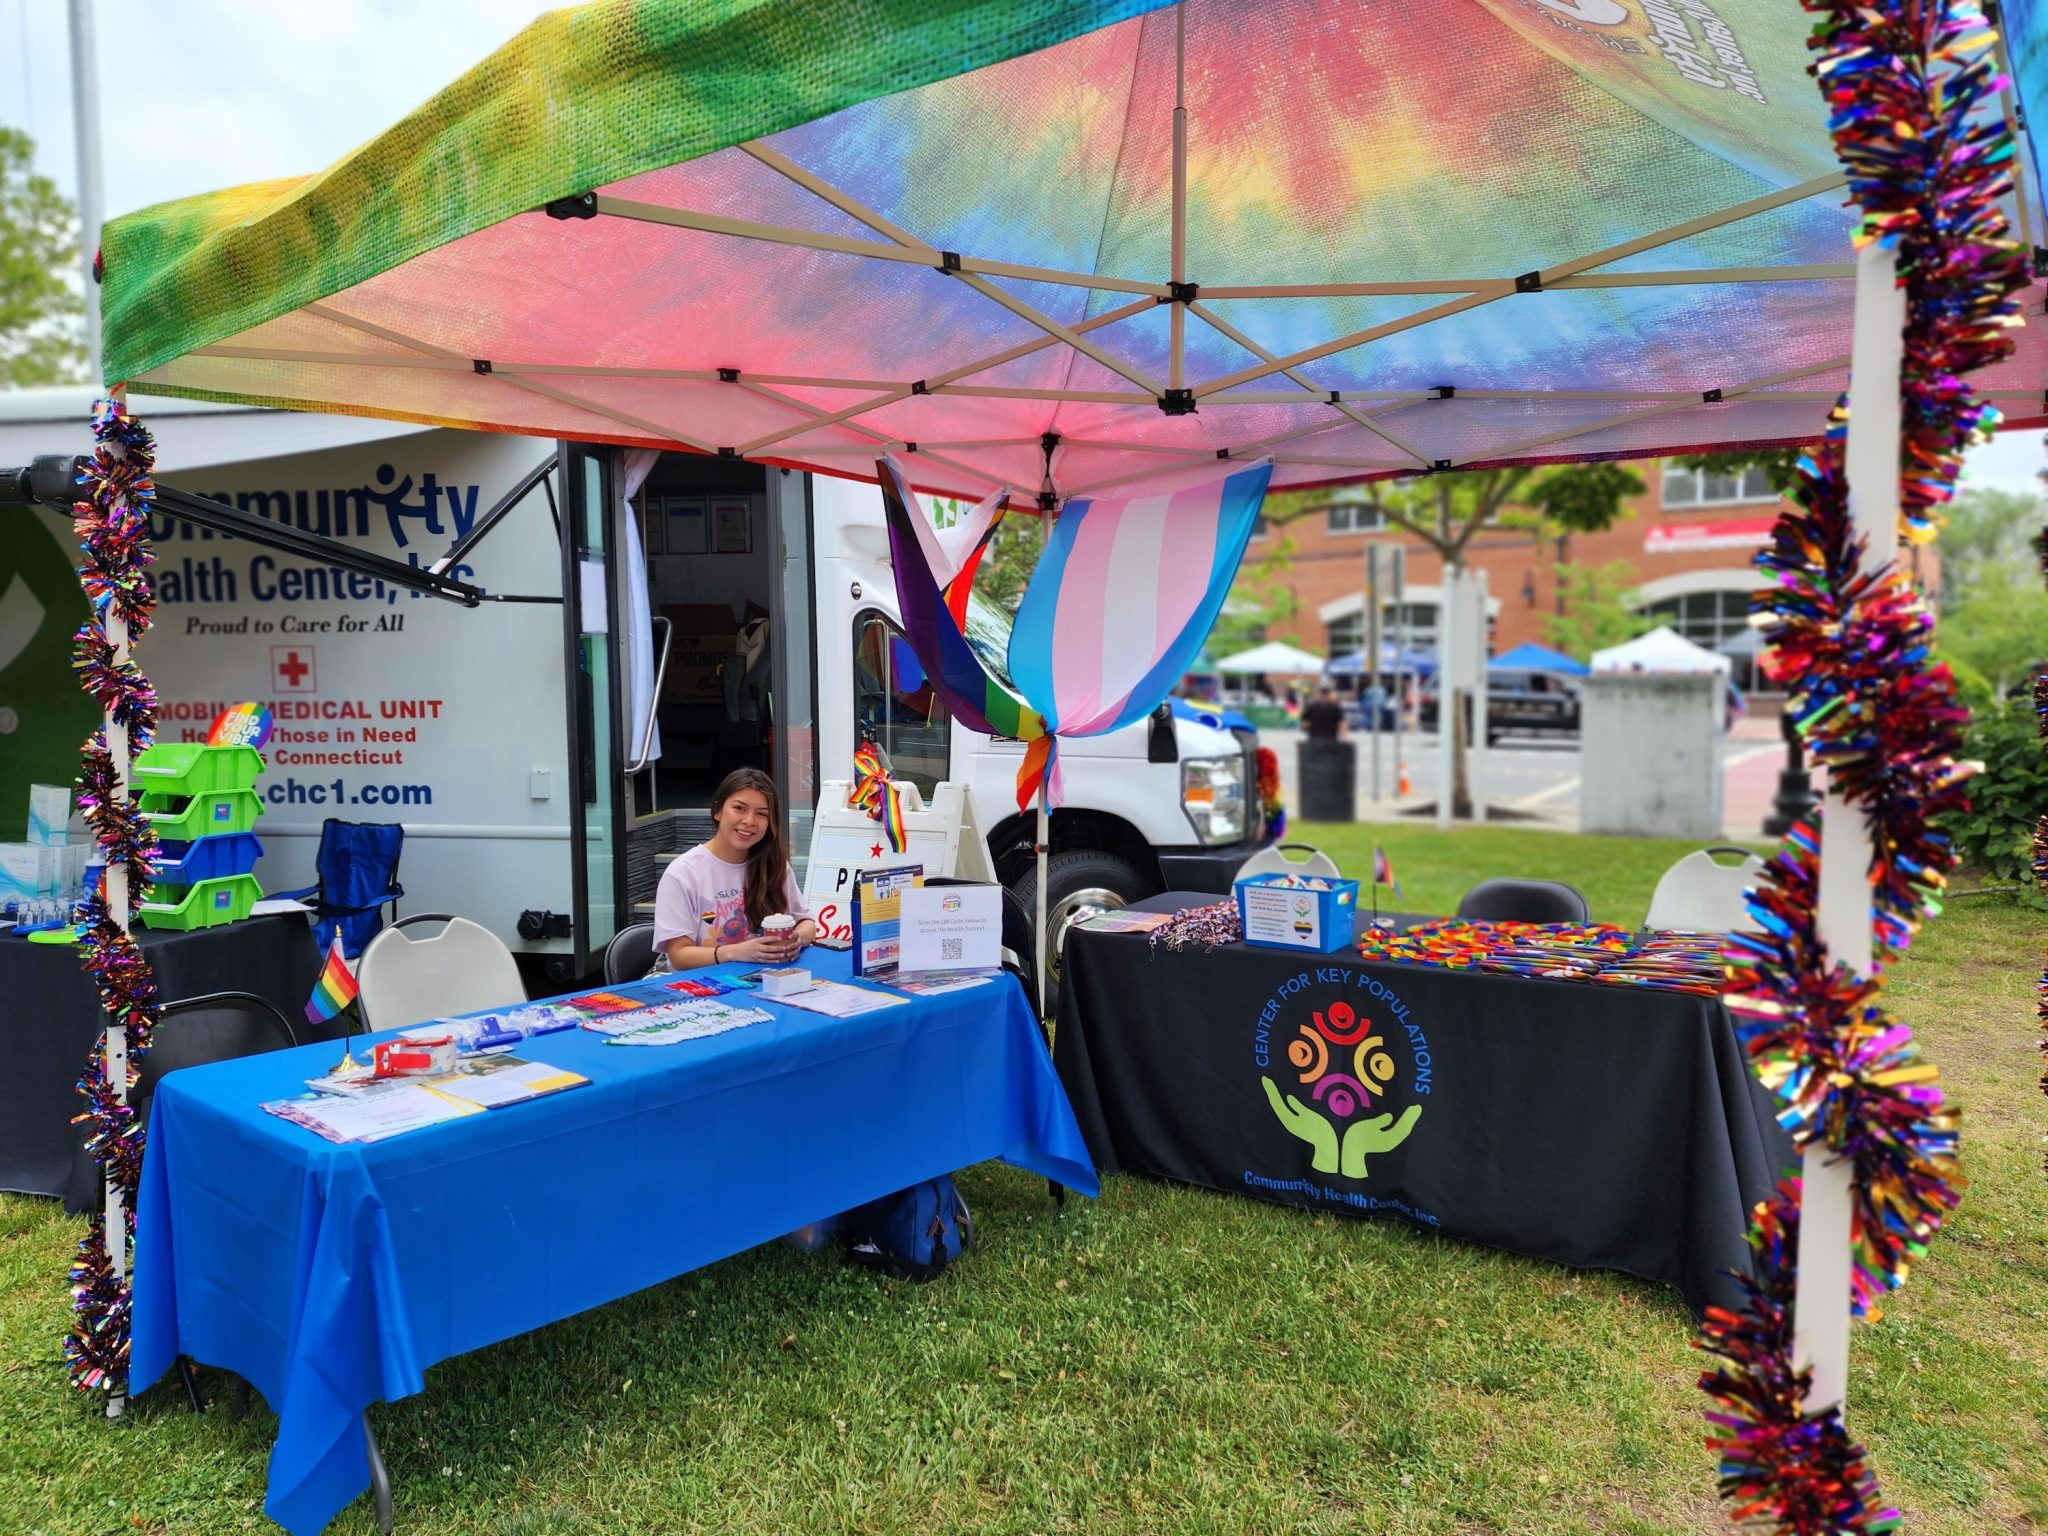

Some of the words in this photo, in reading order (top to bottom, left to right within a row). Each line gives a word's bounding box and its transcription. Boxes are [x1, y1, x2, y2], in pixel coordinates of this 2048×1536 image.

[148, 463, 479, 549] ommunity
[147, 556, 238, 604] ealth
[250, 554, 397, 605] Center,
[185, 616, 249, 635] Proud
[253, 618, 274, 634] to
[279, 615, 331, 633] Care
[335, 614, 369, 633] for
[373, 613, 405, 632] All
[225, 711, 260, 727] FIND
[379, 700, 443, 719] UNIT
[223, 718, 262, 738] YOUR
[269, 728, 327, 743] Those
[336, 728, 356, 743] in
[362, 727, 417, 743] Need
[275, 749, 404, 765] Connecticut
[256, 778, 433, 805] .chc1.com
[1255, 998, 1281, 1068] CENTER
[1278, 973, 1312, 1001] FOR
[1316, 967, 1352, 984] KEY
[1357, 974, 1433, 1095] POPULATIONS
[1243, 1170, 1321, 1200] Community
[1324, 1187, 1368, 1209] Health
[1415, 1207, 1441, 1228] Inc.
